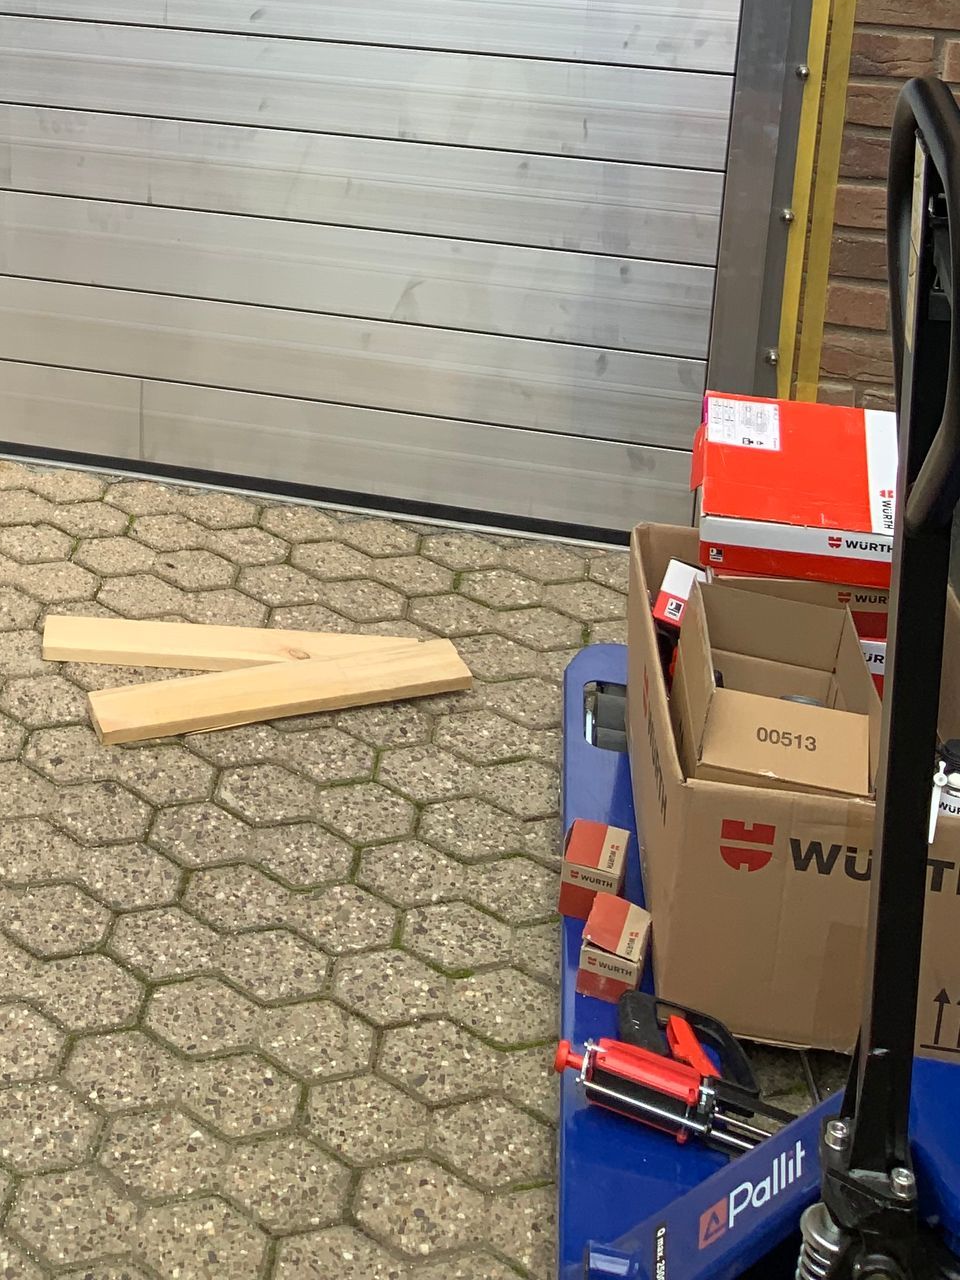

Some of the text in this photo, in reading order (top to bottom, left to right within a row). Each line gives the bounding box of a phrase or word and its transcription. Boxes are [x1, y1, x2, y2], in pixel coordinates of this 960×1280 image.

[882, 500, 894, 529] WÜRTH
[755, 725, 818, 752] 00513
[728, 1140, 806, 1229] Pallit
